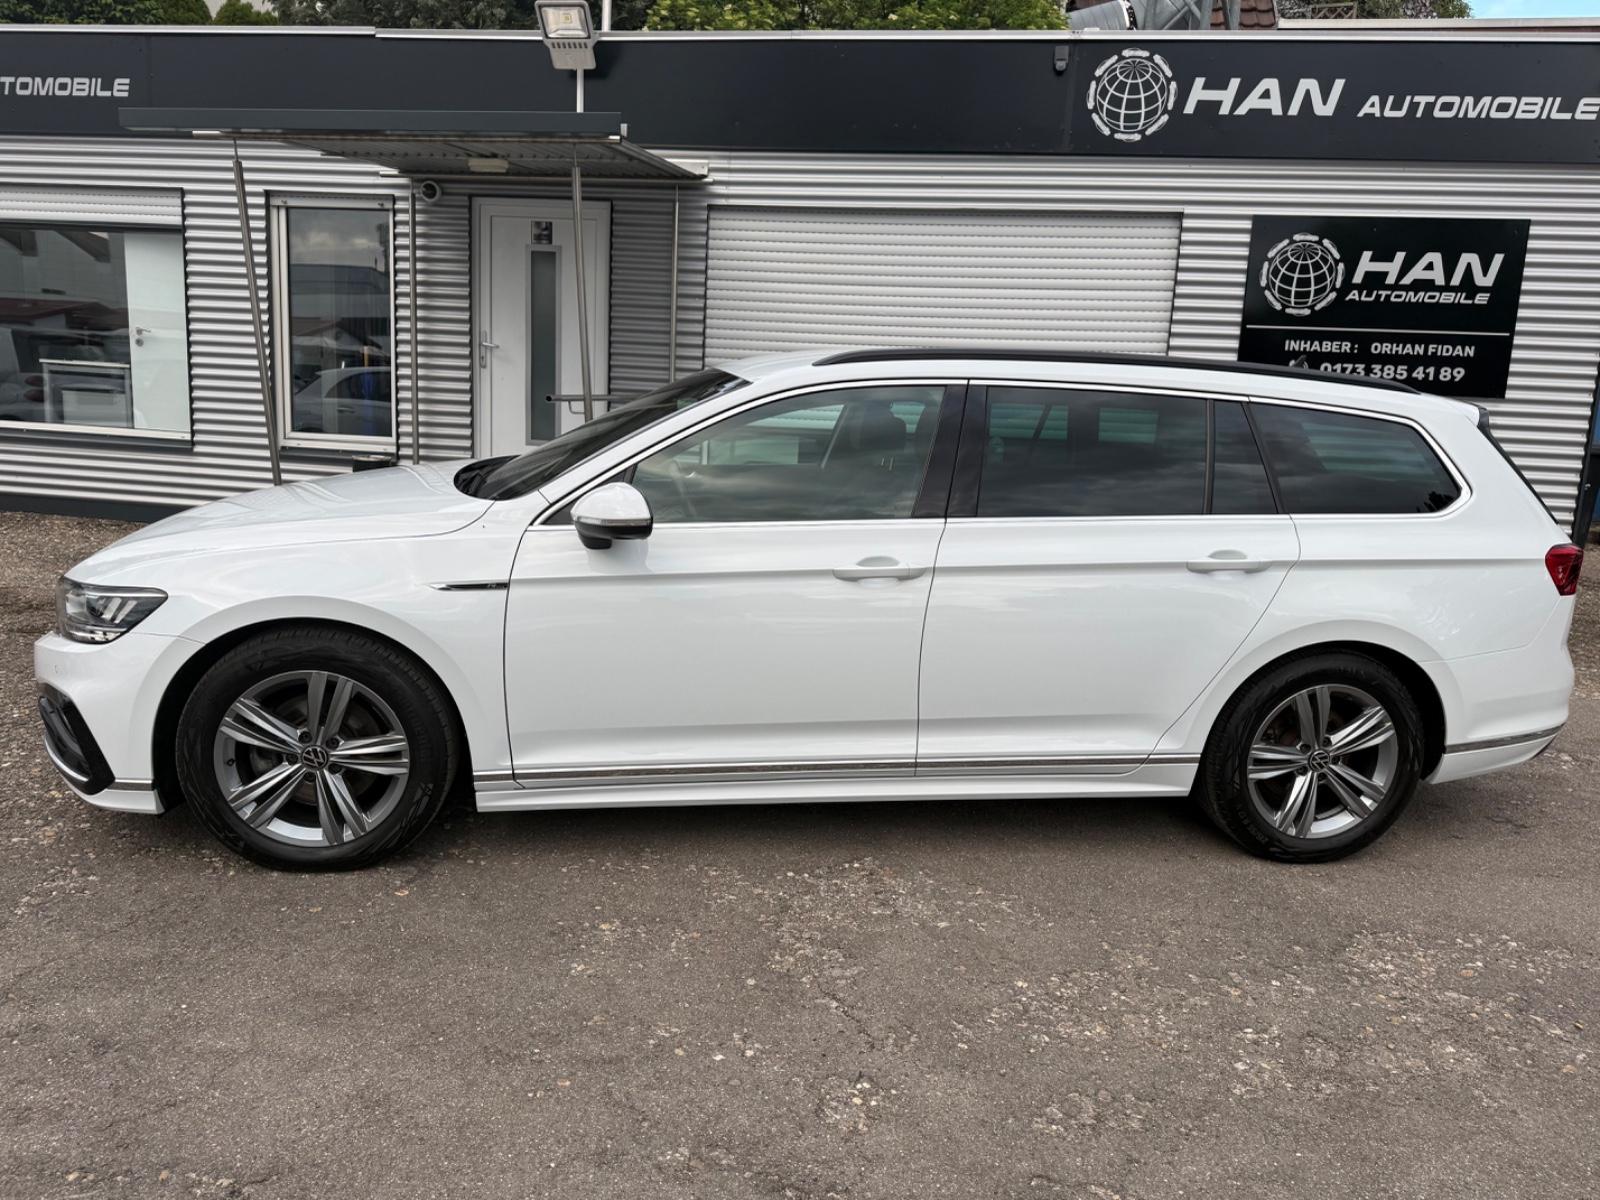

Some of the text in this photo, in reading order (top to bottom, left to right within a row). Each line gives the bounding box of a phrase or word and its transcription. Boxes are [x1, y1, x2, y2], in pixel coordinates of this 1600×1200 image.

[0, 76, 130, 97] TOMOBILE
[1183, 77, 1600, 120] HAN AUTOMOBILE
[1351, 250, 1505, 287] HAN
[1345, 289, 1490, 305] AUTOMOBILE
[1370, 342, 1424, 356] ORHAN
[1427, 344, 1475, 358] FIDAN
[1369, 364, 1408, 380] 385
